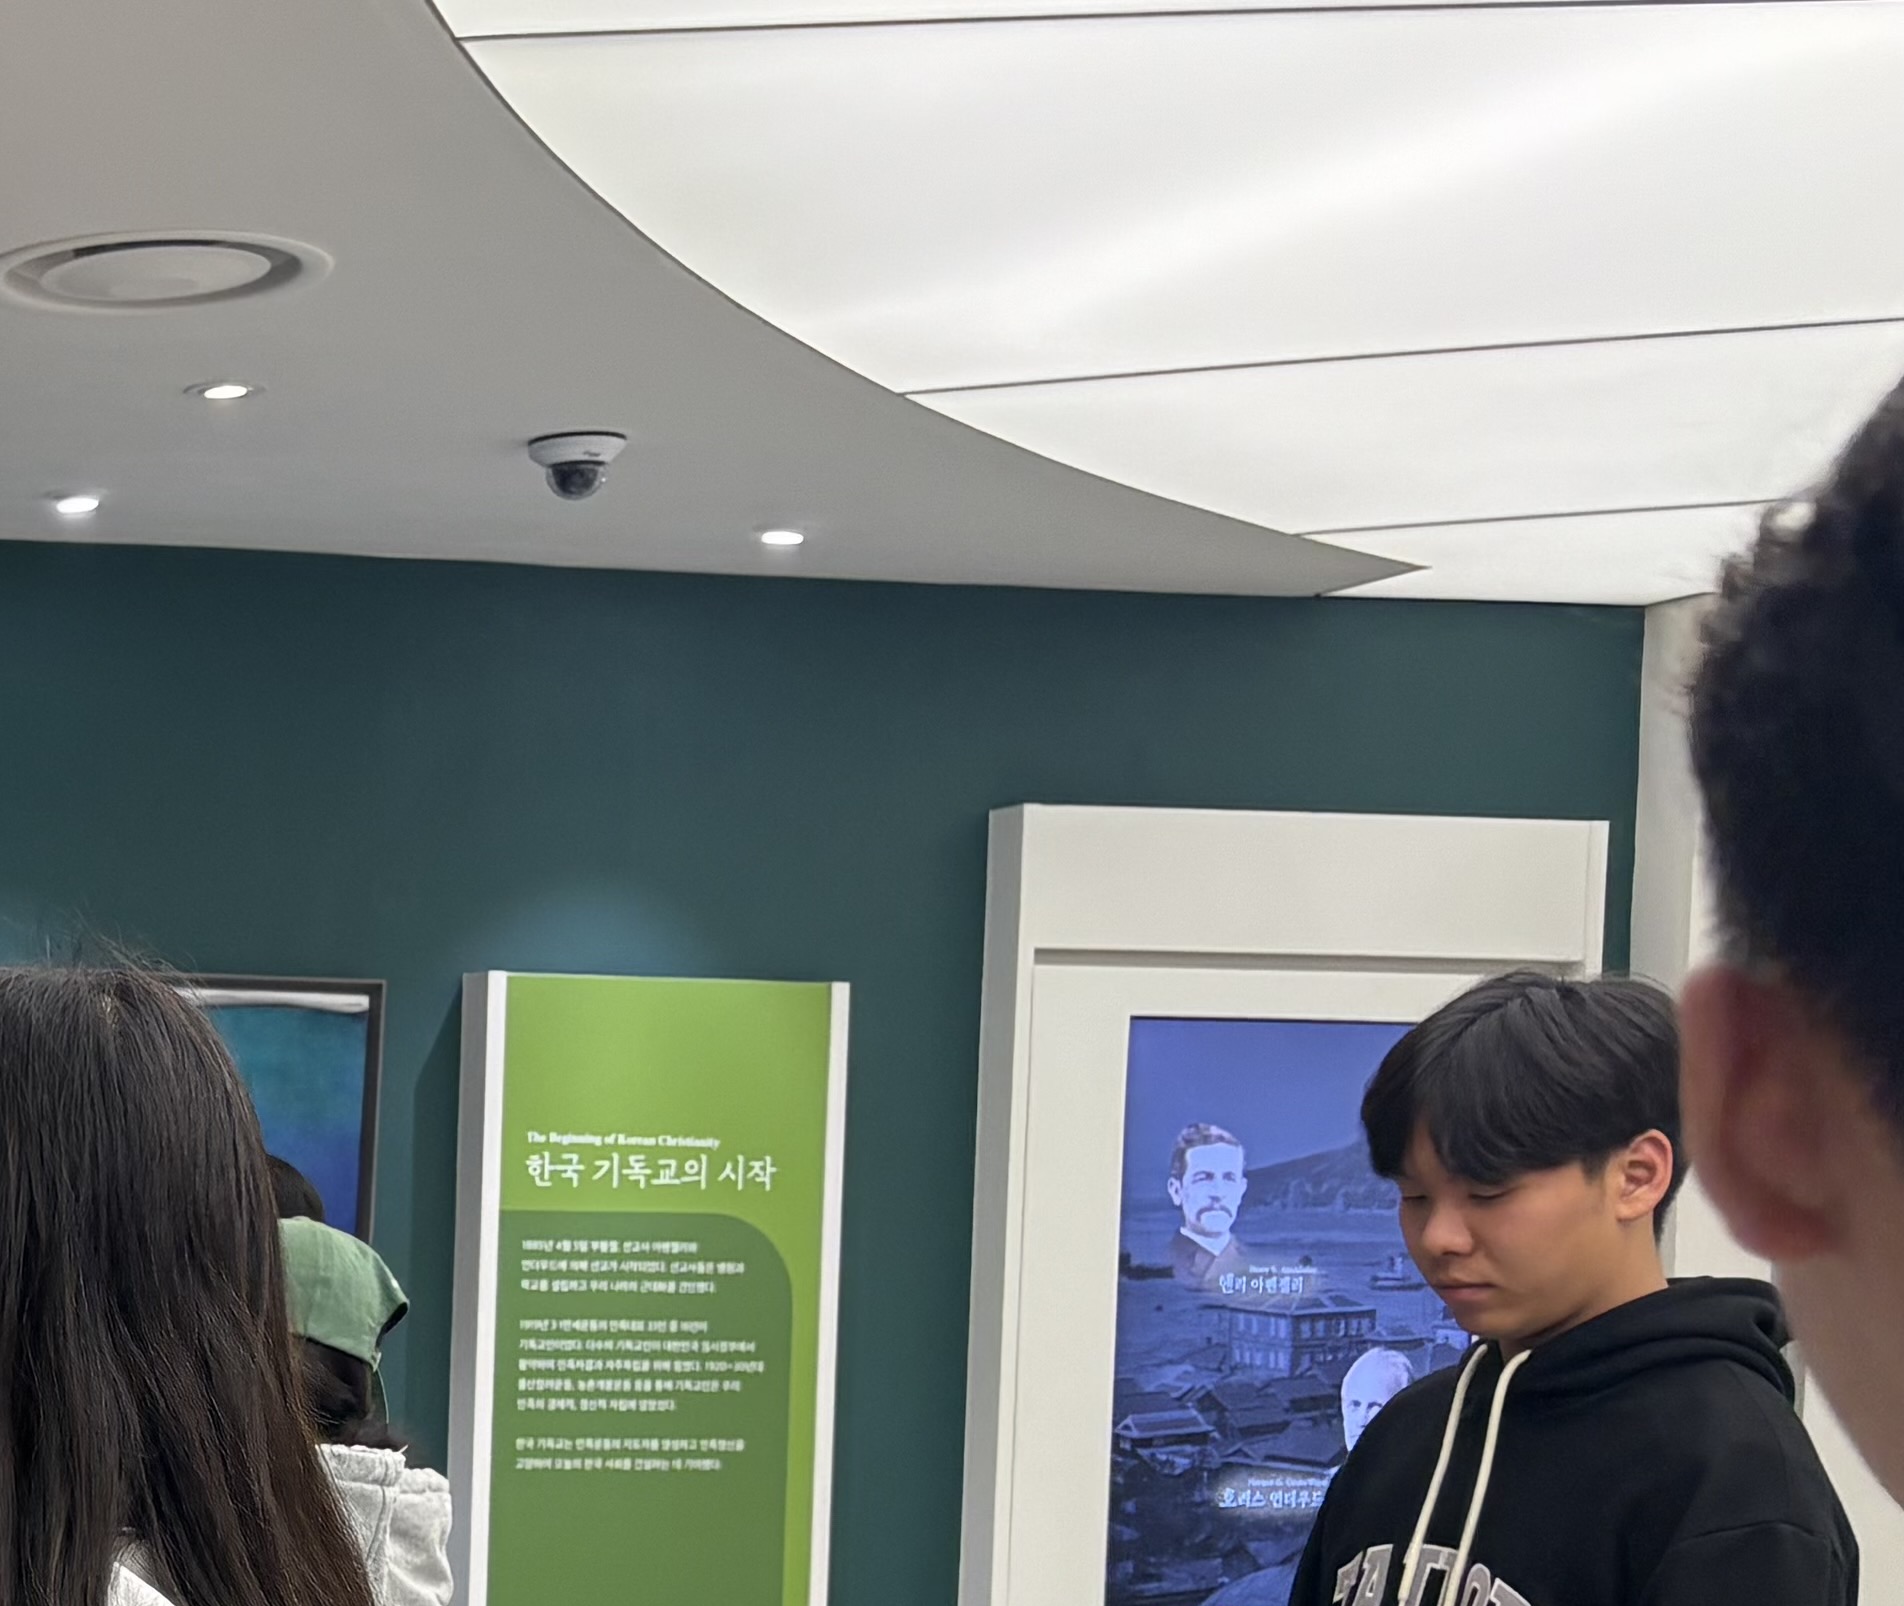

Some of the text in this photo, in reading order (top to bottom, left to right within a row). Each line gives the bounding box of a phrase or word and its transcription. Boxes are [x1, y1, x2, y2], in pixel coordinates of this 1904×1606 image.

[604, 1133, 616, 1145] of
[526, 1151, 778, 1191] 한국 기독교의 시작
